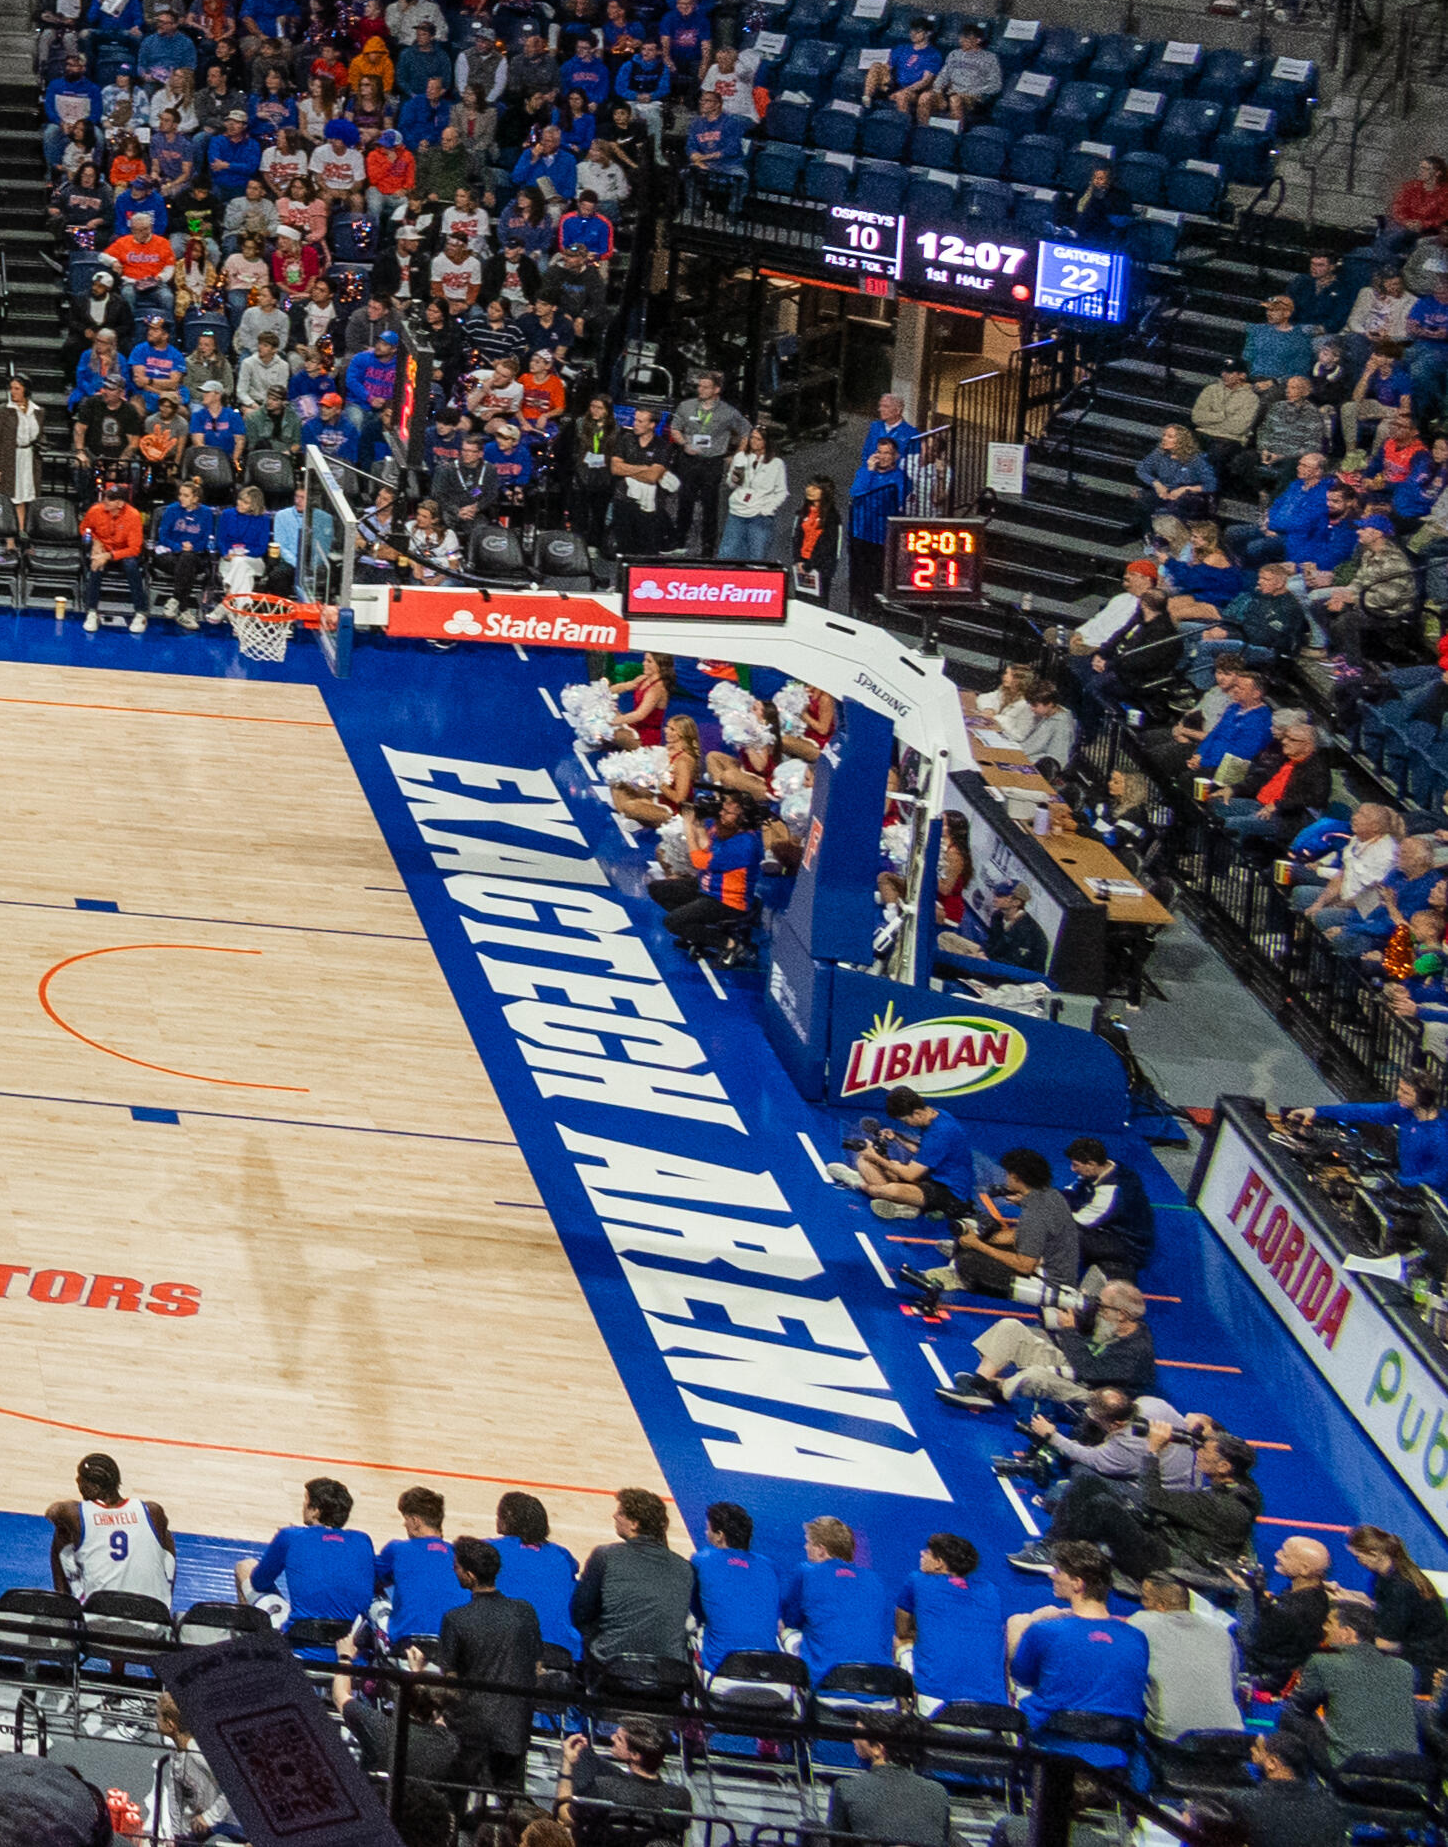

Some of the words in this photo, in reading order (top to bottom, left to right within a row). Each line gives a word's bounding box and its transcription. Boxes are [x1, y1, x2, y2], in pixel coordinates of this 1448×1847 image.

[832, 206, 894, 228] OSPREYS
[845, 224, 878, 251] 10
[916, 231, 1027, 274] 12:07
[1053, 246, 1111, 267] GATORS
[925, 267, 948, 284] 1st
[956, 273, 994, 290] HALF
[1060, 264, 1098, 291] 22
[907, 531, 973, 553] 12:07
[912, 559, 958, 589] 21
[665, 581, 773, 604] StateFarm
[484, 612, 617, 645] StateFarm
[854, 672, 912, 719] SPALDING
[380, 744, 749, 1136] EXACTECH
[841, 1031, 1010, 1096] LIBMAN
[1226, 1166, 1354, 1351] FLORIDA
[555, 1121, 953, 1503] ARENA
[94, 1513, 138, 1527] CHINYELU
[109, 1531, 129, 1561] 9
